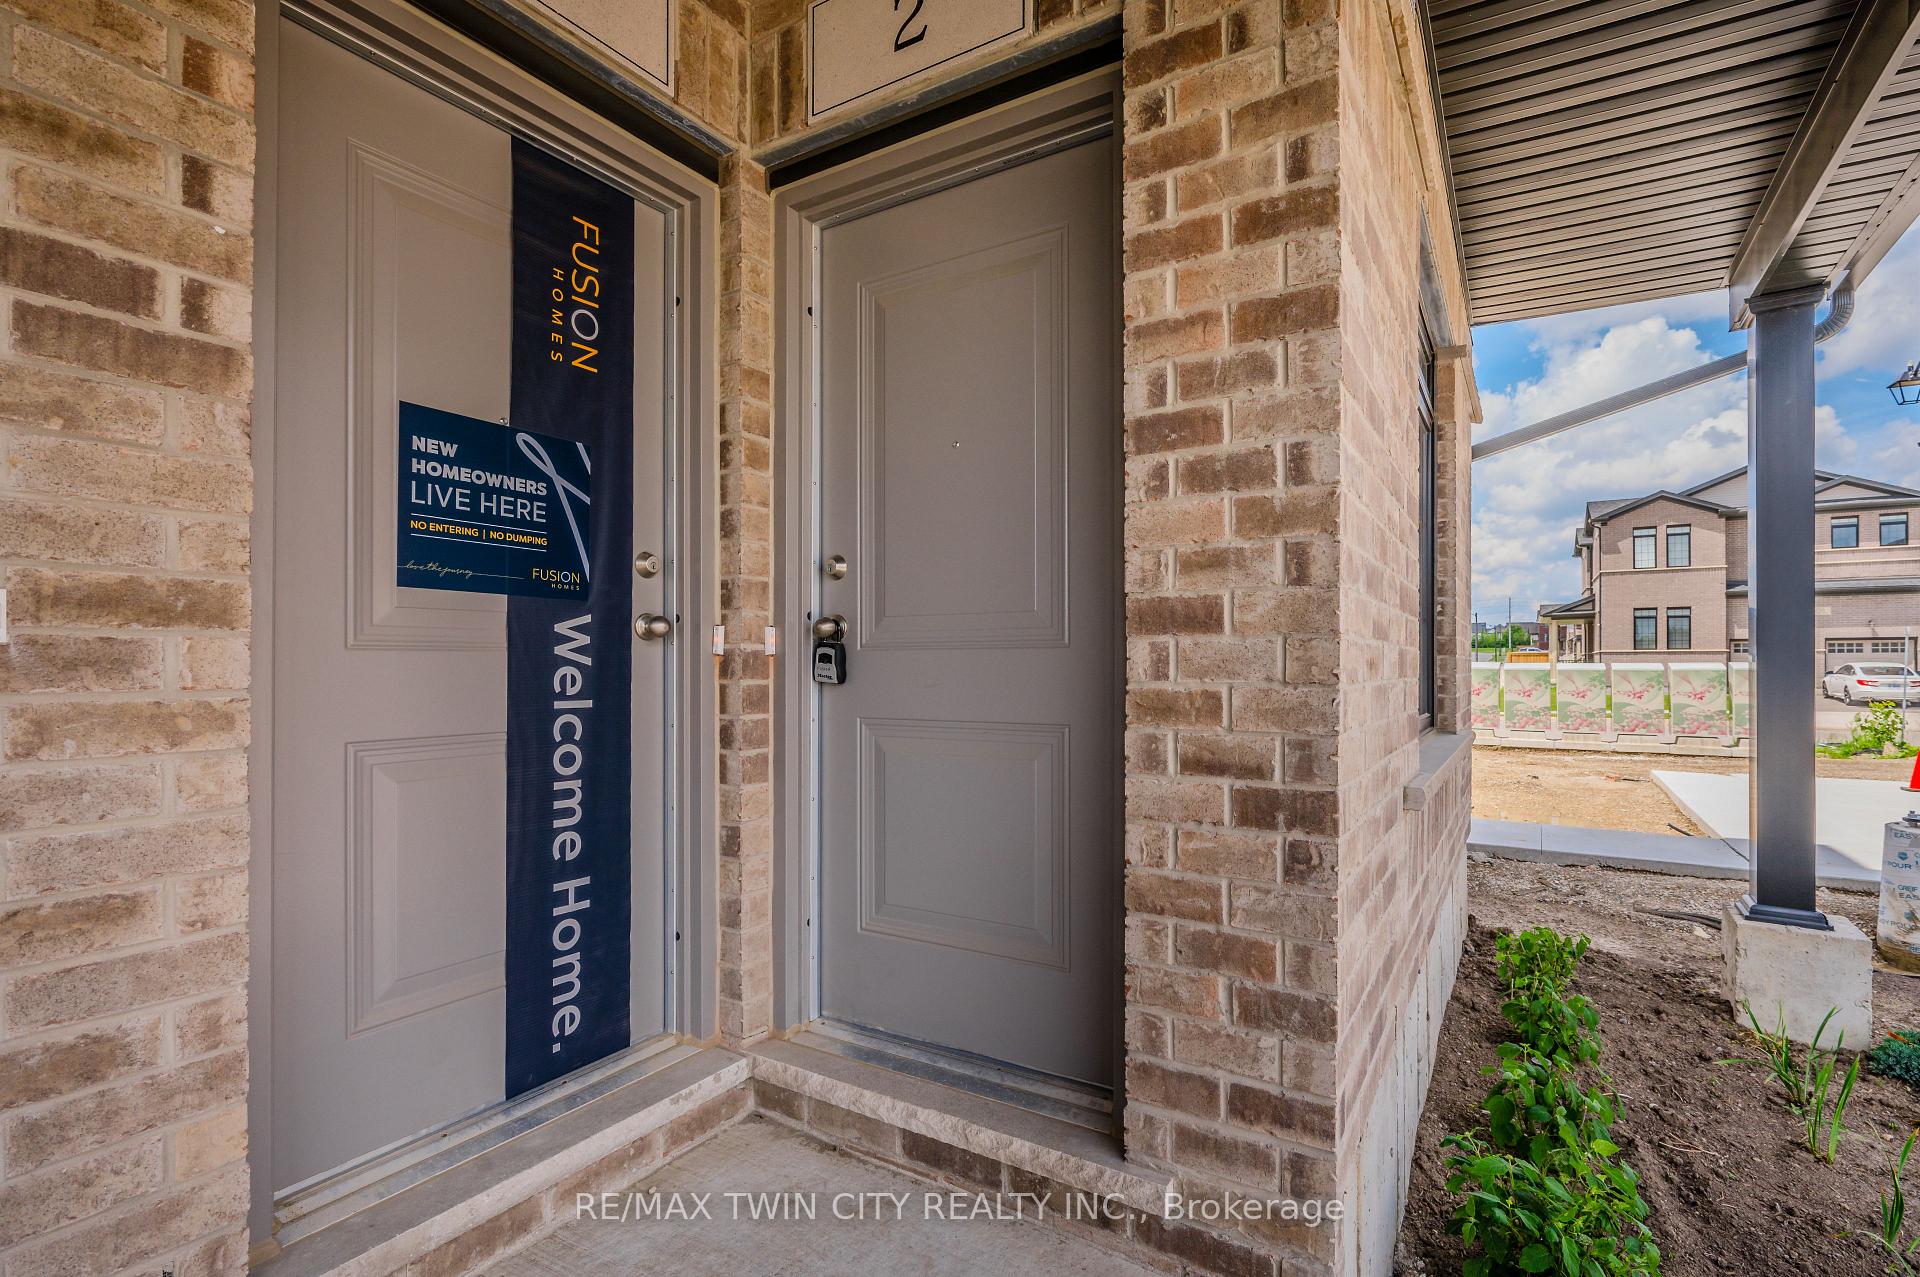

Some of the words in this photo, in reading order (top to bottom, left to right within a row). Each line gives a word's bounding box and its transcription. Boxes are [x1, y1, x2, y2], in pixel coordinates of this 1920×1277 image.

[893, 0, 928, 53] 2
[551, 267, 565, 362] HOMES
[571, 215, 600, 374] FUSION
[411, 435, 458, 457] NEW
[411, 457, 547, 496] HOMEOWNERS
[411, 480, 471, 511] LIVE
[480, 492, 547, 523] HERE
[410, 520, 427, 530] NO
[429, 523, 479, 537] ENTERING
[489, 530, 504, 540] NO
[506, 532, 548, 546] DUMPING
[532, 568, 580, 583] FUSION
[551, 583, 580, 591] HOMES
[553, 614, 593, 862] Welcome
[552, 876, 591, 1053] Home.
